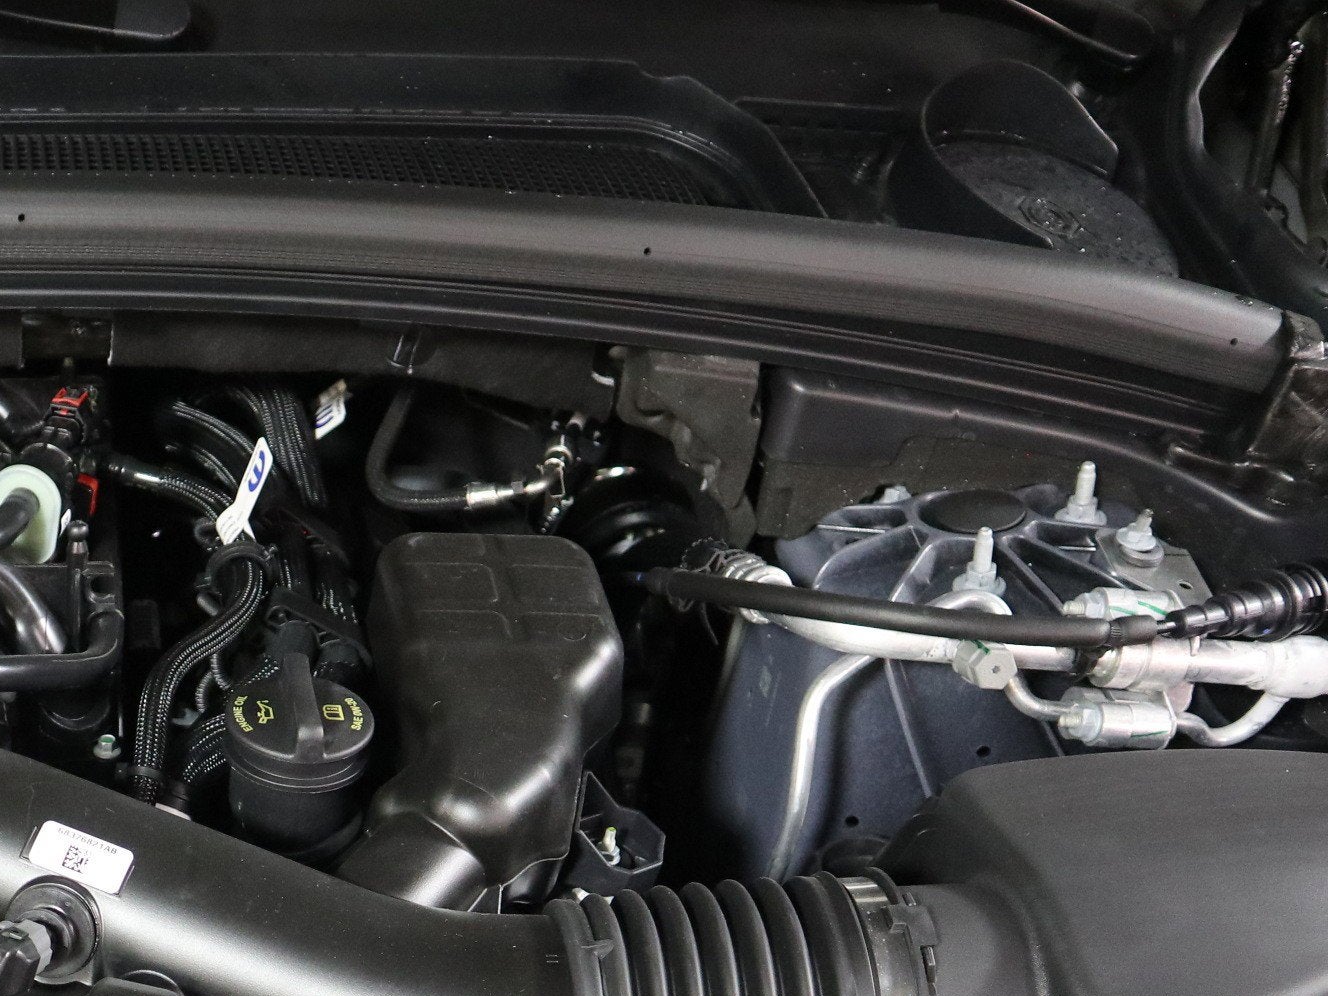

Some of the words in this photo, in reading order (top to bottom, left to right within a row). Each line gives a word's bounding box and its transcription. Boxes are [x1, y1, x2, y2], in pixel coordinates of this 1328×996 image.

[234, 695, 248, 706] OIL
[232, 706, 253, 733] ENGINE
[350, 715, 364, 731] SAE
